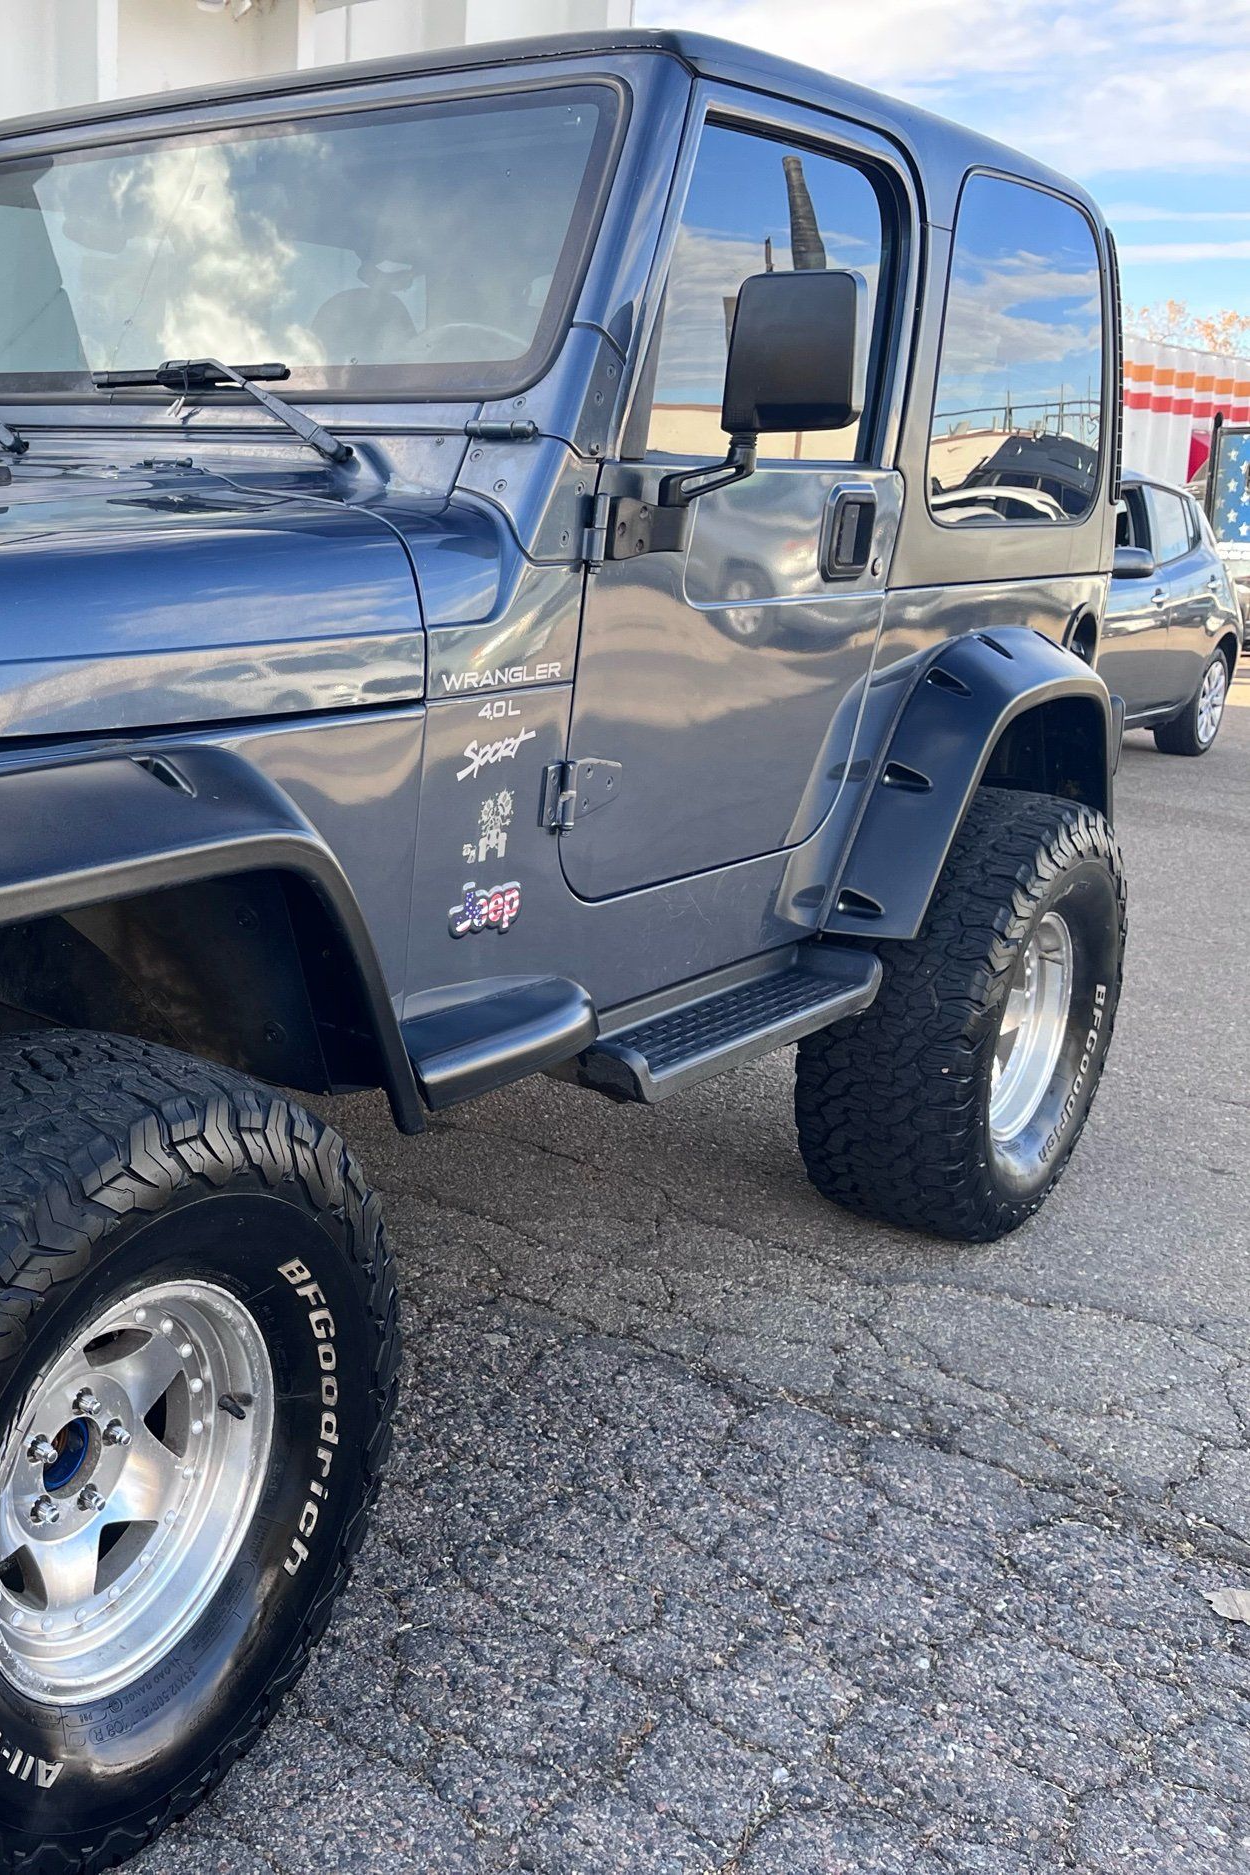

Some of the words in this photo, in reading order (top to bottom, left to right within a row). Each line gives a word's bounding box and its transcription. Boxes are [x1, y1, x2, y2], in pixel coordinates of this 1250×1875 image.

[441, 661, 563, 692] WRANGLER
[456, 727, 537, 782] Sport
[449, 881, 521, 938] Jeep
[1037, 983, 1107, 1163] BFGoodrich
[277, 1257, 340, 1577] BFGoodrich
